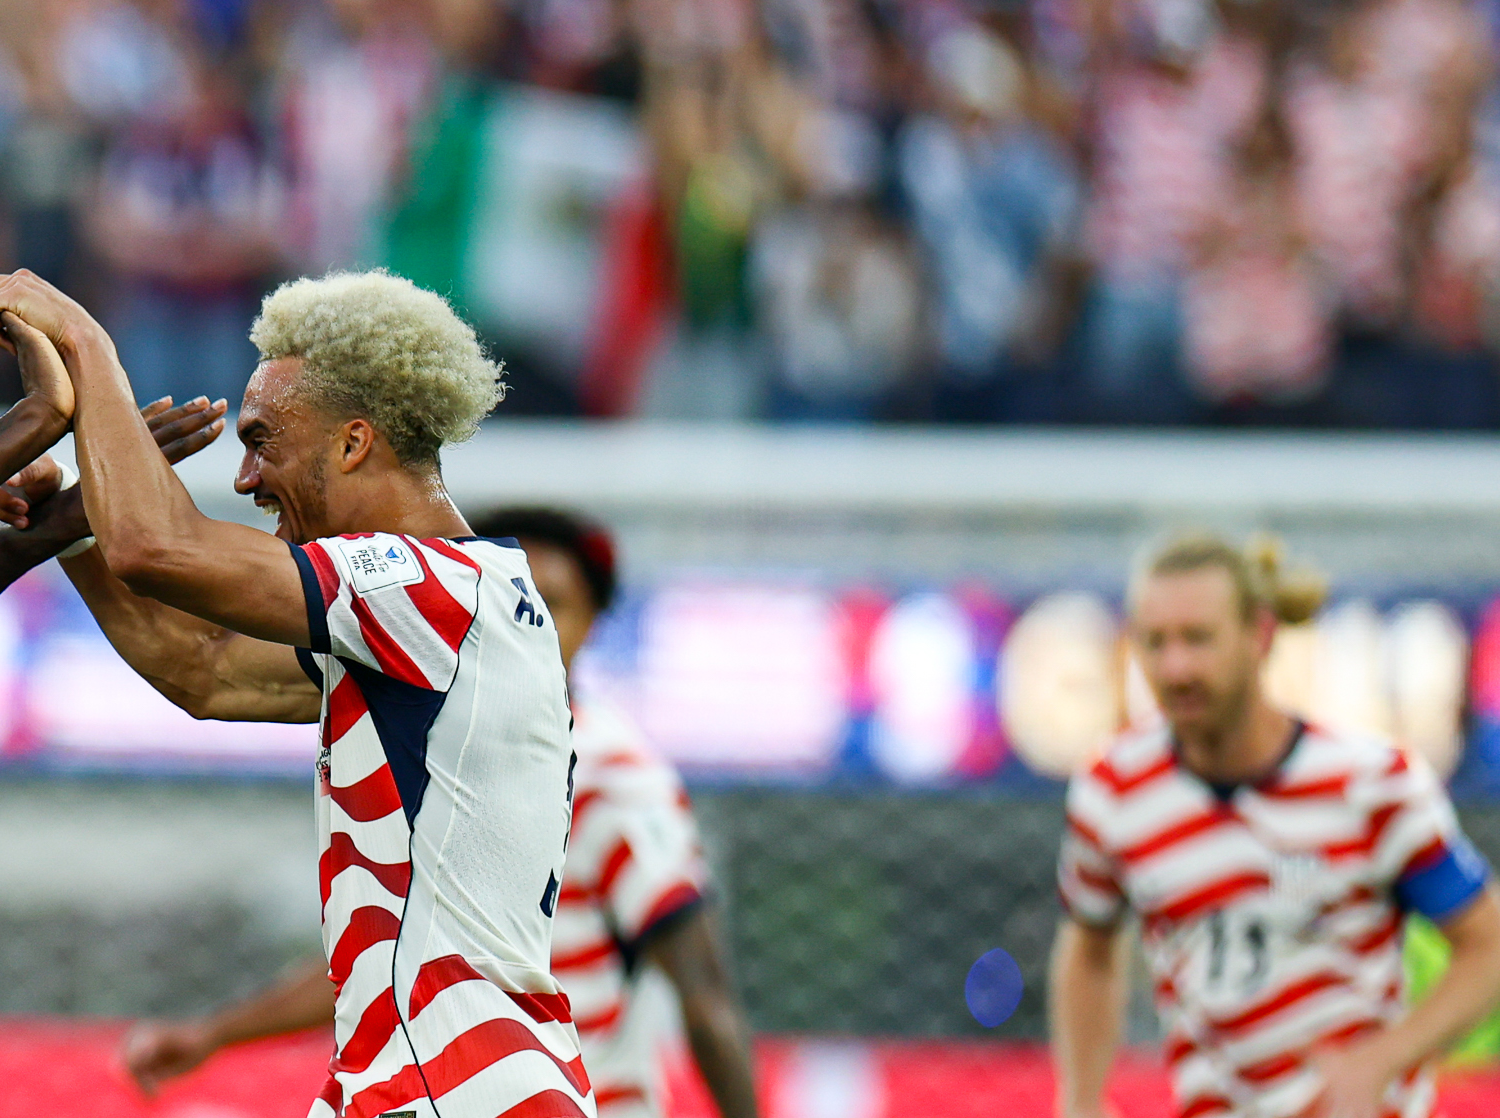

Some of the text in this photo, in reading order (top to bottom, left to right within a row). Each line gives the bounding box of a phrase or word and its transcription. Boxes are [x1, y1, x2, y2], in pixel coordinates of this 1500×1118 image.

[350, 555, 361, 571] FIFA
[356, 549, 377, 576] PEACE
[1206, 906, 1272, 988] 13
